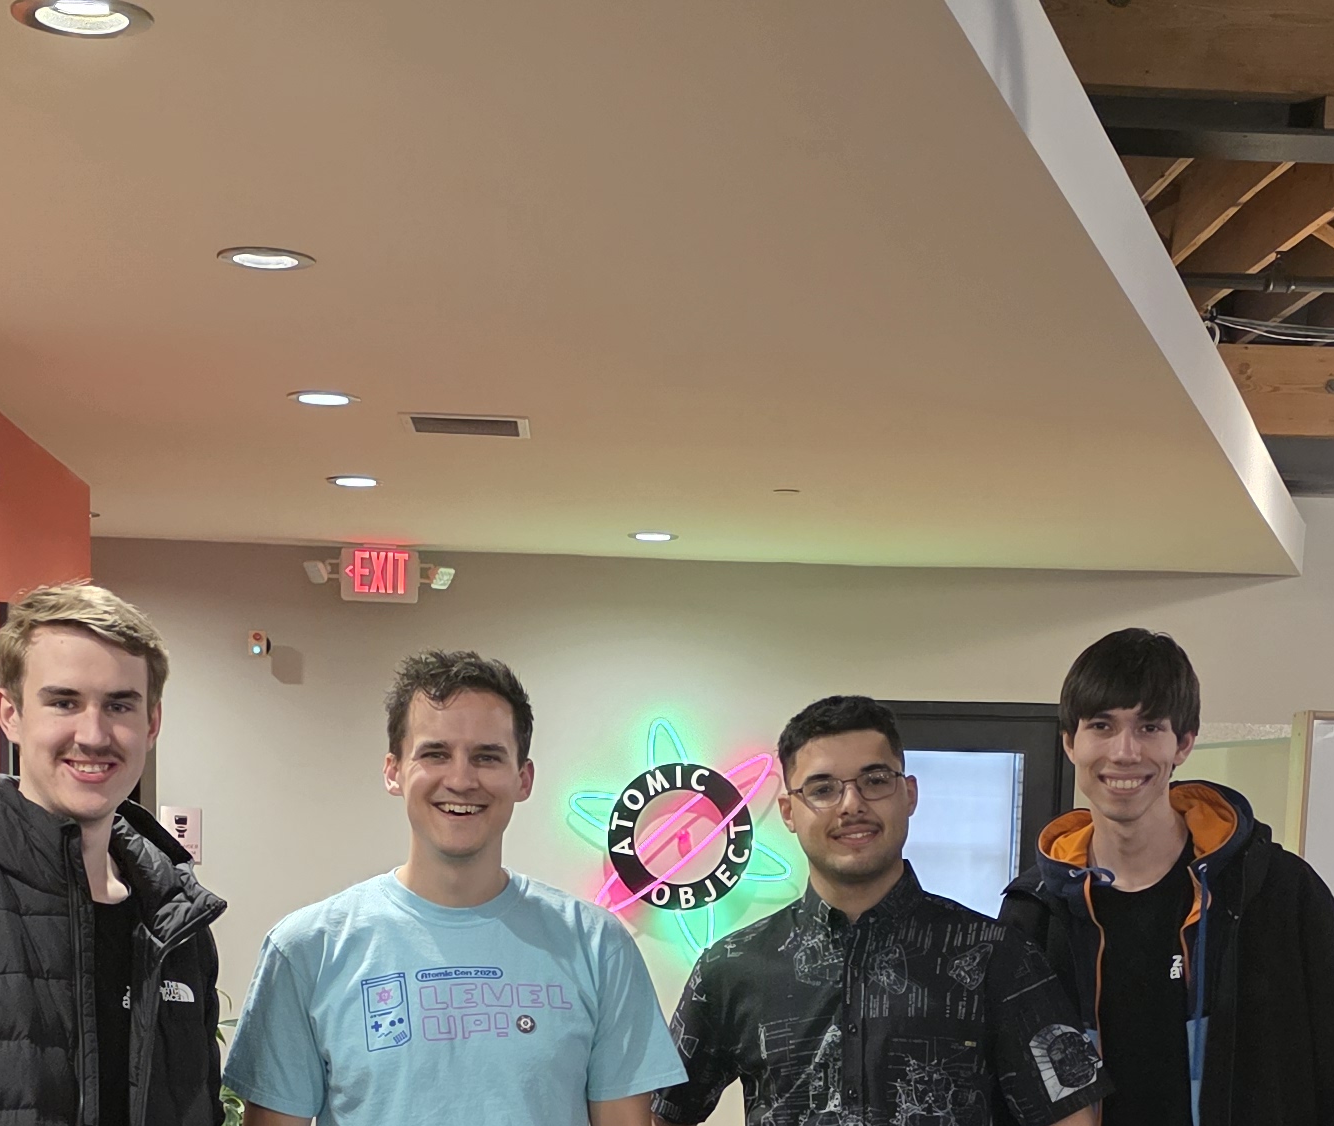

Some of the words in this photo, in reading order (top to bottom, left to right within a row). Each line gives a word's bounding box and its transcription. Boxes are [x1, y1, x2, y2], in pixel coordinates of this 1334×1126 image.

[354, 550, 409, 594] EXIT
[611, 765, 710, 856] ATOMIC
[651, 820, 751, 909] OBJECT
[420, 970, 453, 980] Atomic
[419, 982, 573, 1011] LEVEL
[422, 1011, 510, 1042] UP!
